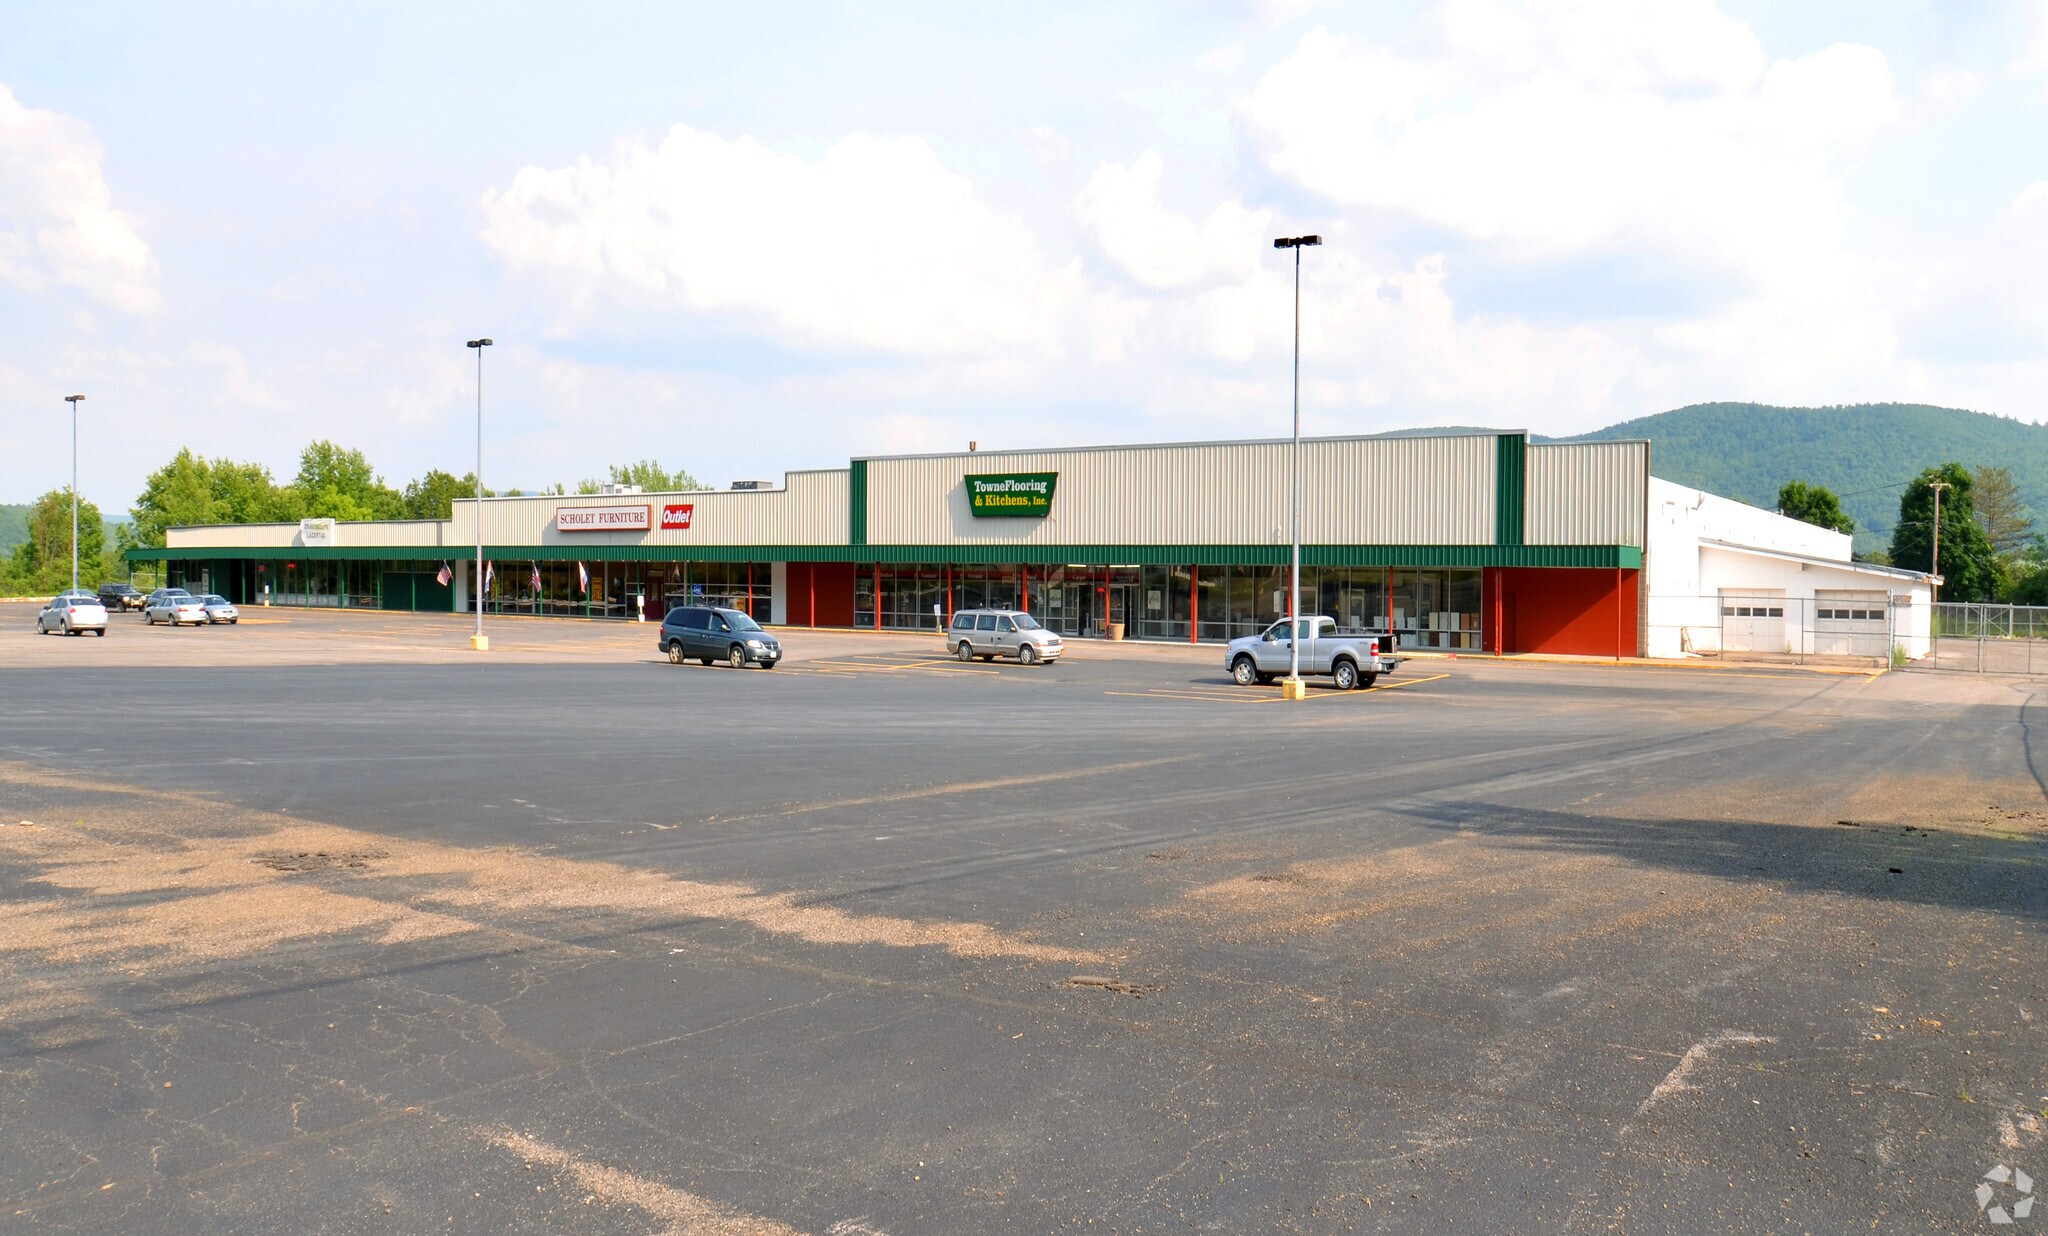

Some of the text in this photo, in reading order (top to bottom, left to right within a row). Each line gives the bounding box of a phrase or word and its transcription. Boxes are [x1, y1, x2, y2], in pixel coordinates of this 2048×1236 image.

[974, 479, 1047, 494] TowneFlooring
[975, 494, 1047, 507] & Kitchens, Inc.
[560, 511, 645, 524] SCHOLET FURNITURE
[663, 509, 691, 524] Outlet
